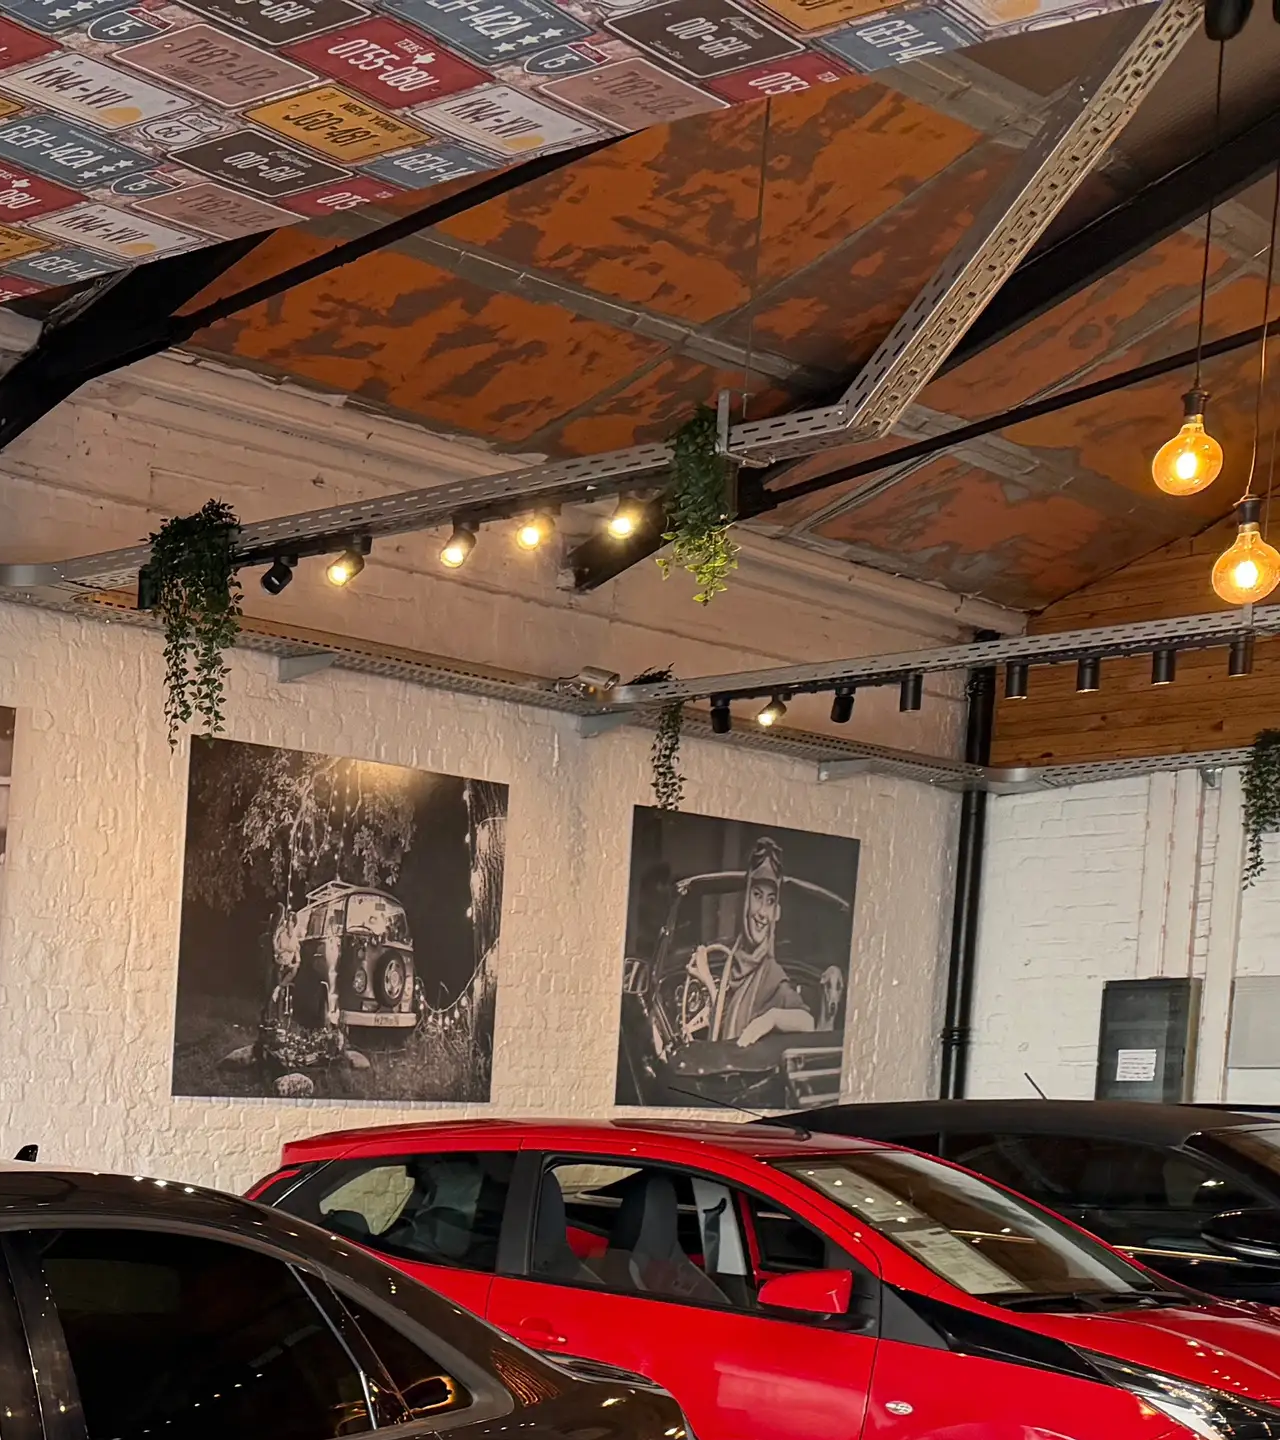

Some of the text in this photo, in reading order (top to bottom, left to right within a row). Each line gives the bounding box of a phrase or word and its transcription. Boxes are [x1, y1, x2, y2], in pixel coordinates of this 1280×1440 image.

[102, 20, 135, 36] 15
[539, 53, 579, 68] 15
[25, 66, 132, 110] KN4-XV1
[339, 102, 403, 133] NEW YORK
[155, 123, 184, 138] 66
